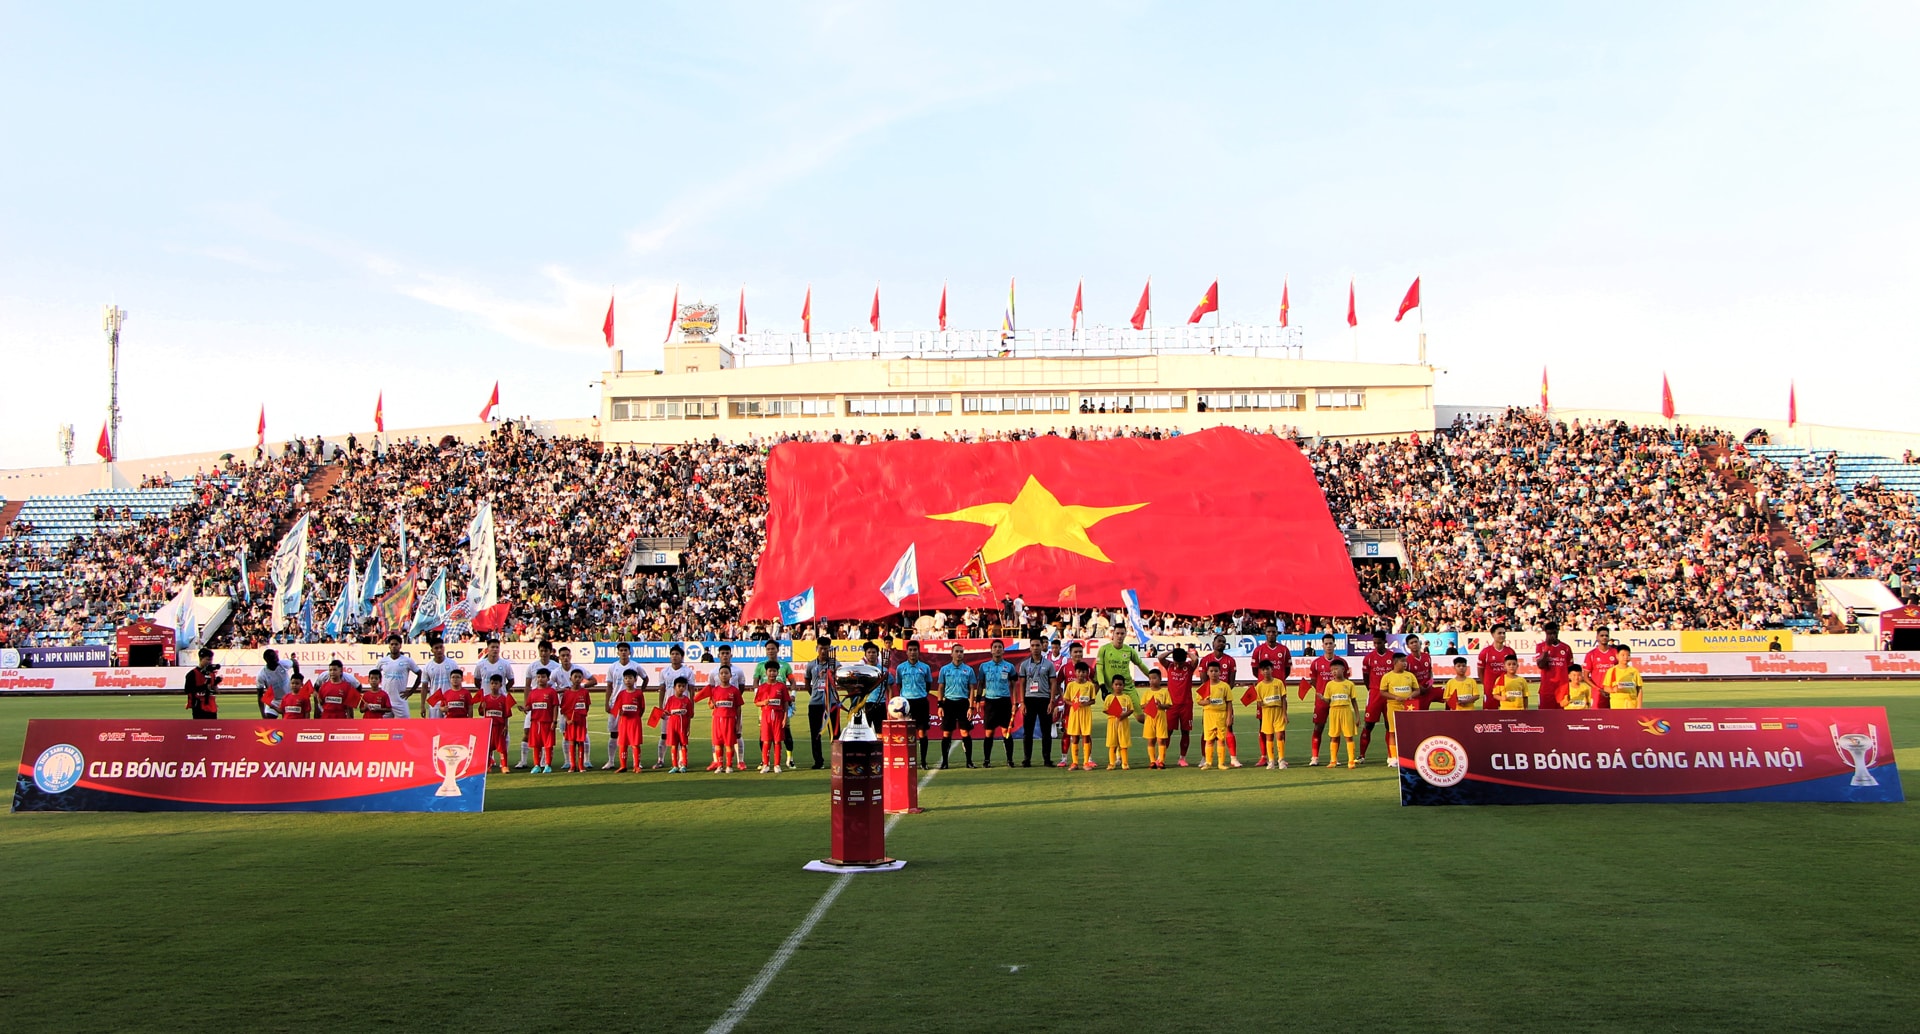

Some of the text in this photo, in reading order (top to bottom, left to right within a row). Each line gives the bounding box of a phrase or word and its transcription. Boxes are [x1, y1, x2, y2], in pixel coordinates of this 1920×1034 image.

[1367, 544, 1378, 554] B2
[1630, 638, 1676, 647] THACO
[1739, 635, 1768, 643] BANK
[46, 652, 62, 662] NPK
[64, 652, 84, 662] NINH
[86, 650, 106, 661] BÌNH
[597, 646, 606, 658] XI
[1490, 746, 1803, 772] CLB BÓNG ĐÁ CÔNG AN HÀ NỘI
[89, 757, 414, 782] CLB BÓNG ĐÁ THÉP XANH NAM ĐỊNH
